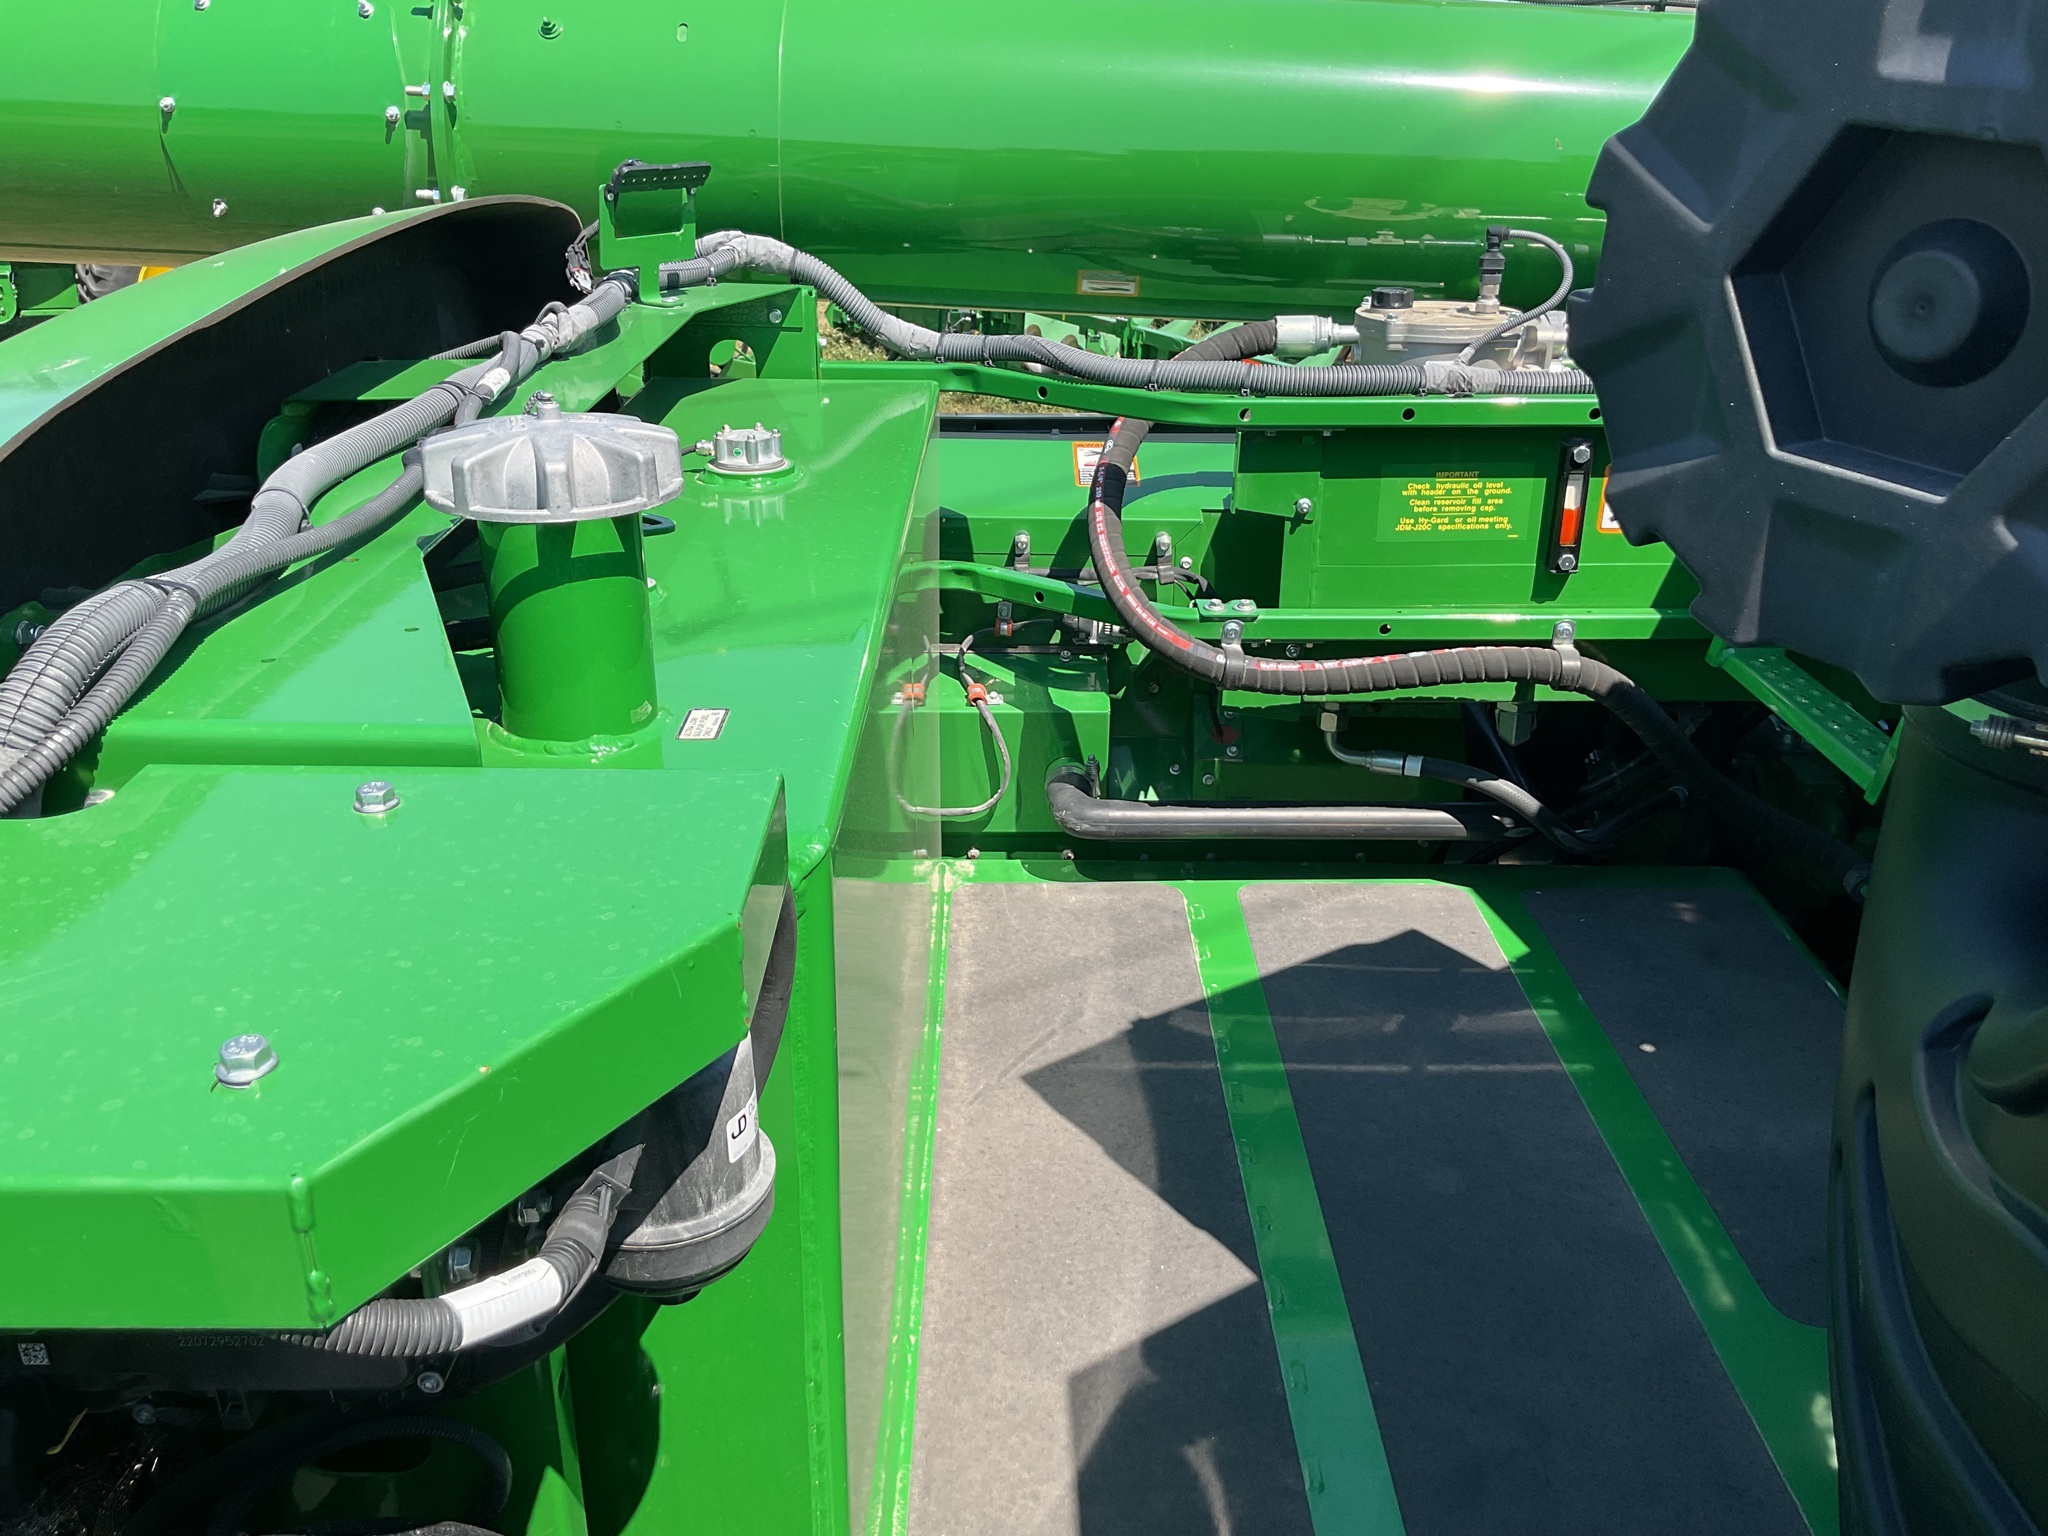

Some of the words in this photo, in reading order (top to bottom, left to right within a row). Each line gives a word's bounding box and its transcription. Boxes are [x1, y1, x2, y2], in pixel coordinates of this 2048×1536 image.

[1407, 482, 1430, 490] Check
[1436, 482, 1469, 491] hydraulic
[1484, 487, 1512, 496] ground.
[1441, 505, 1476, 513] removing
[1418, 517, 1449, 525] Hy-Gard
[1437, 523, 1489, 531] specifications
